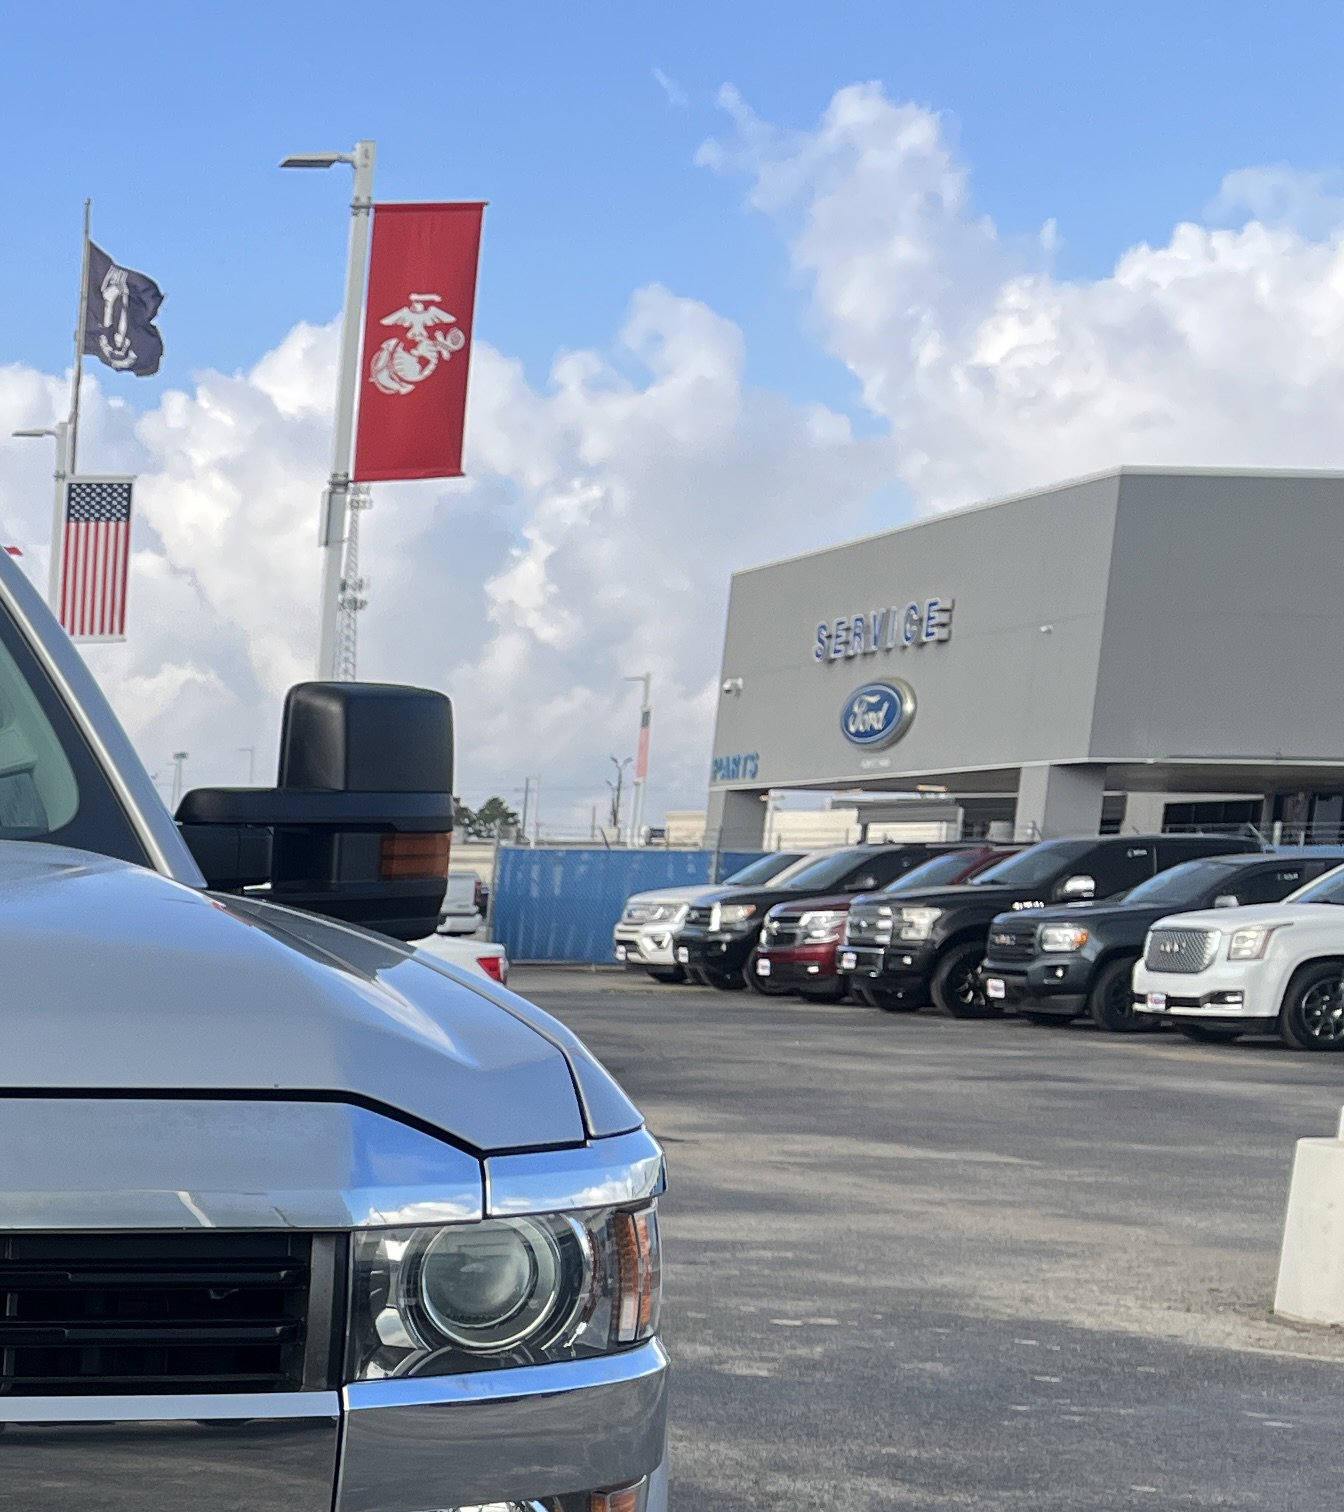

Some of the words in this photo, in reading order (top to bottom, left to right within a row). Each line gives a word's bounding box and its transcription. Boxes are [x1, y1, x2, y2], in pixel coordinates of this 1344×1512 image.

[813, 597, 943, 662] SERVICE
[848, 694, 890, 734] Ford
[712, 752, 760, 781] PARTS
